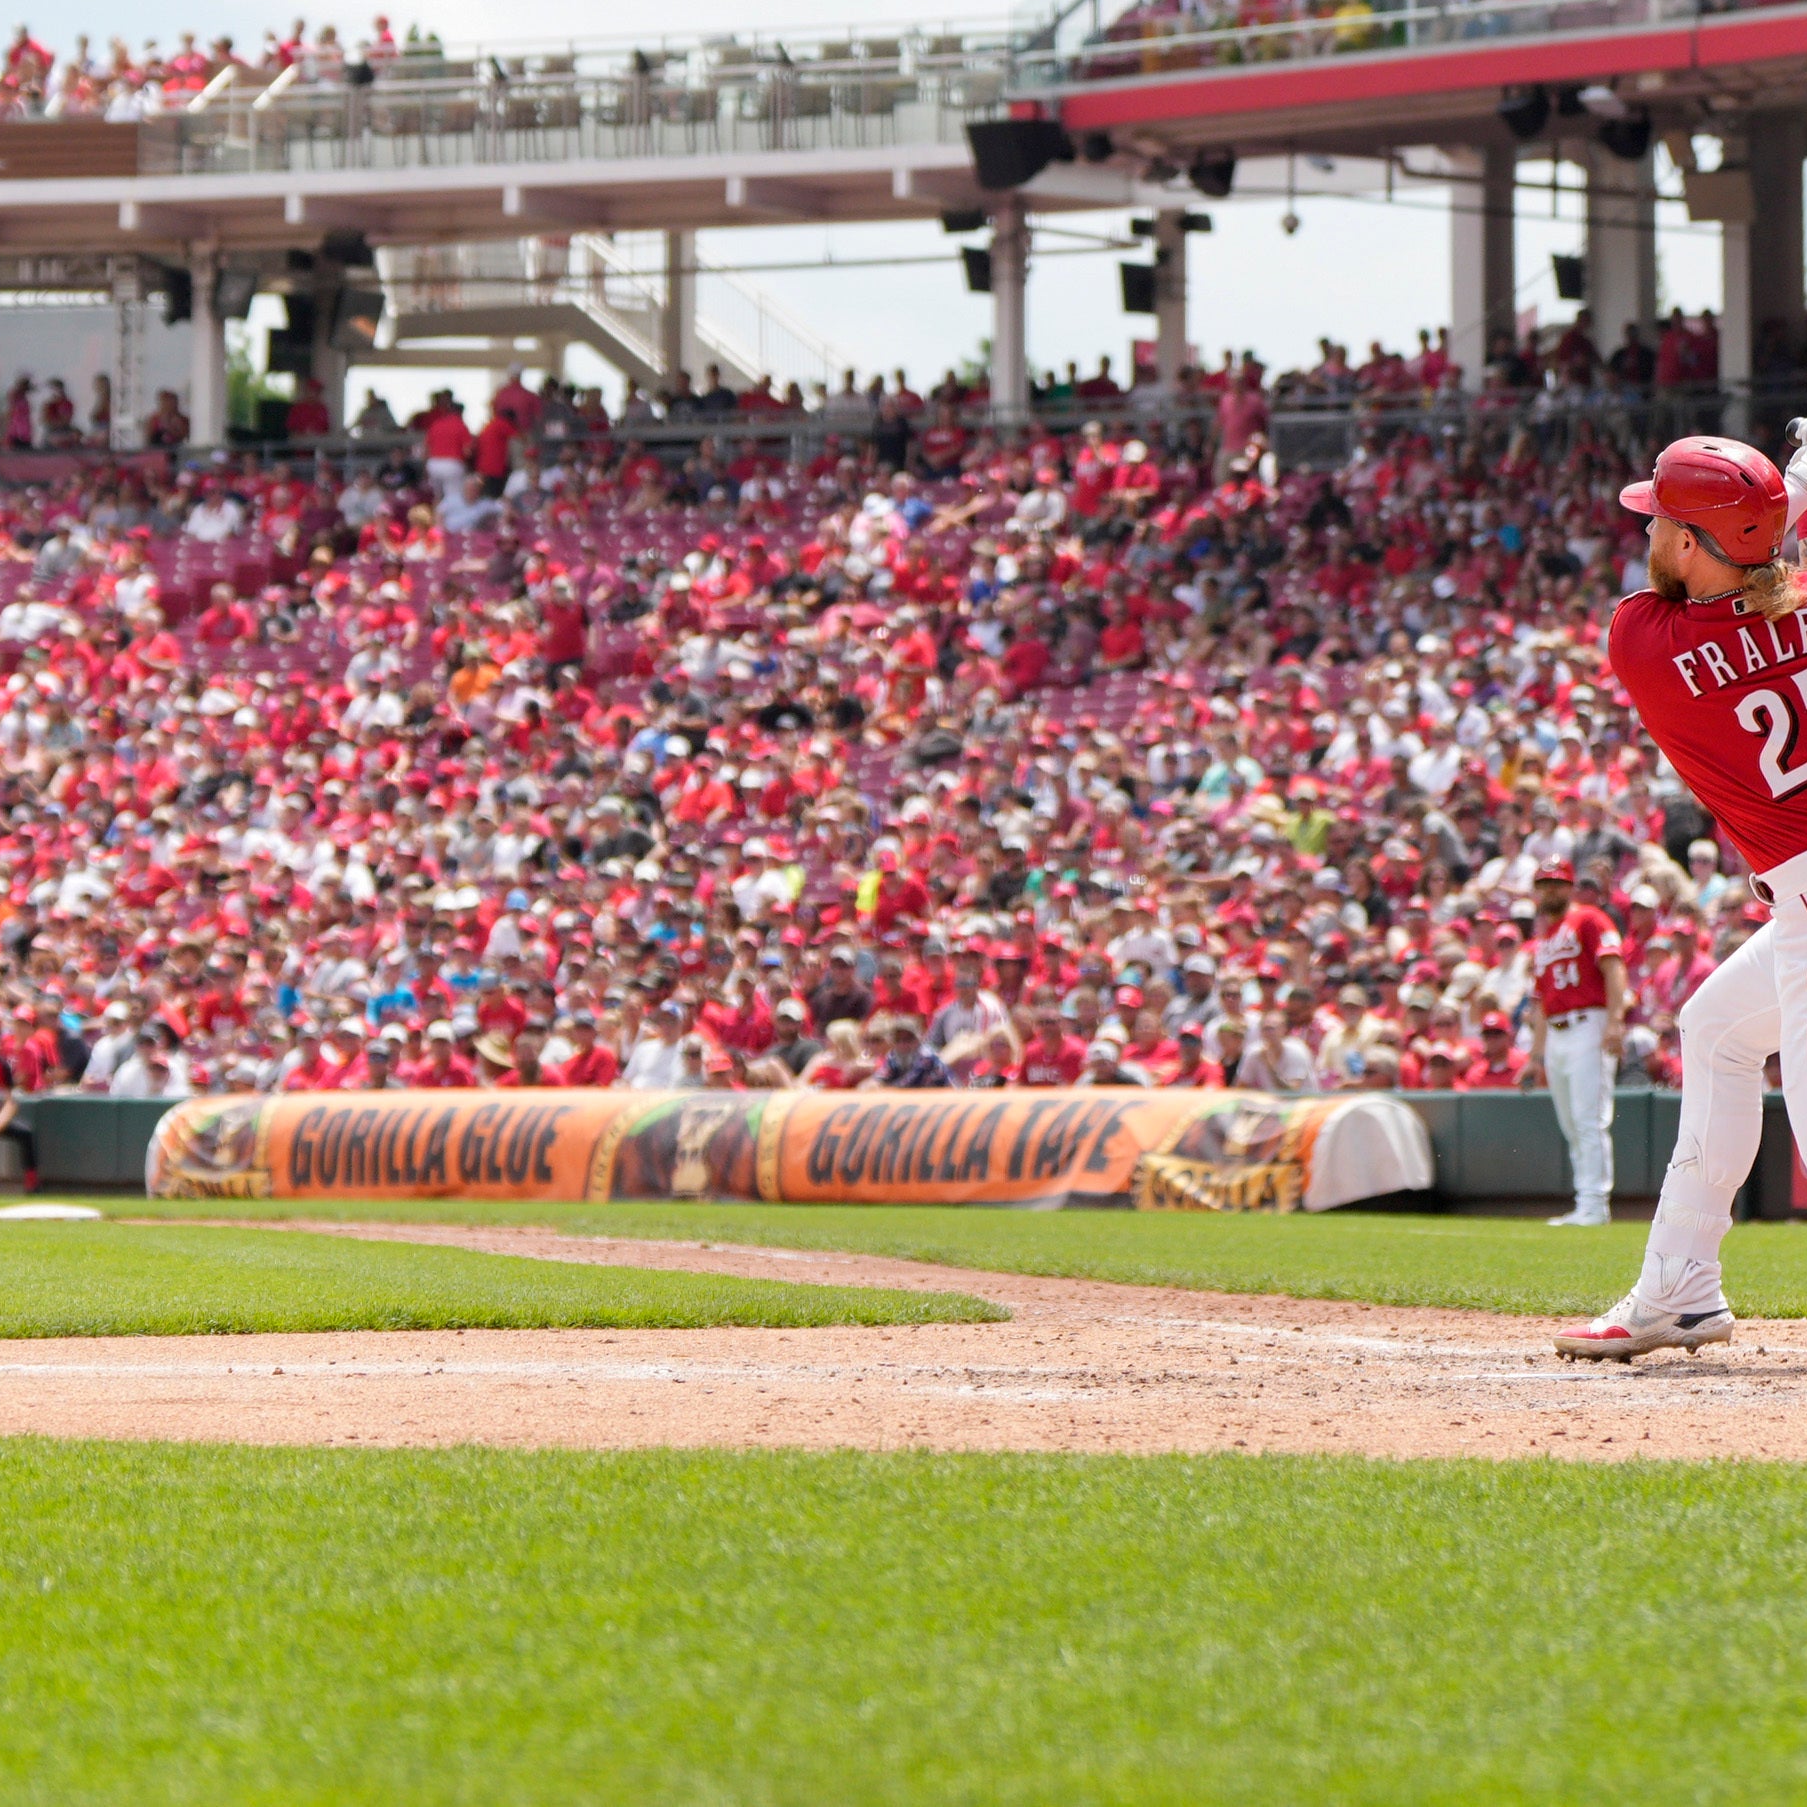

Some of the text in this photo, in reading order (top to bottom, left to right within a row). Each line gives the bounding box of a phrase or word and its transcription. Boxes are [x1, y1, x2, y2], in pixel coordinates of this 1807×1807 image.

[289, 1105, 459, 1189] GORILLA
[458, 1101, 576, 1186] GLUE
[807, 1100, 1008, 1187] GORILLA
[1005, 1097, 1147, 1183] TAPE
